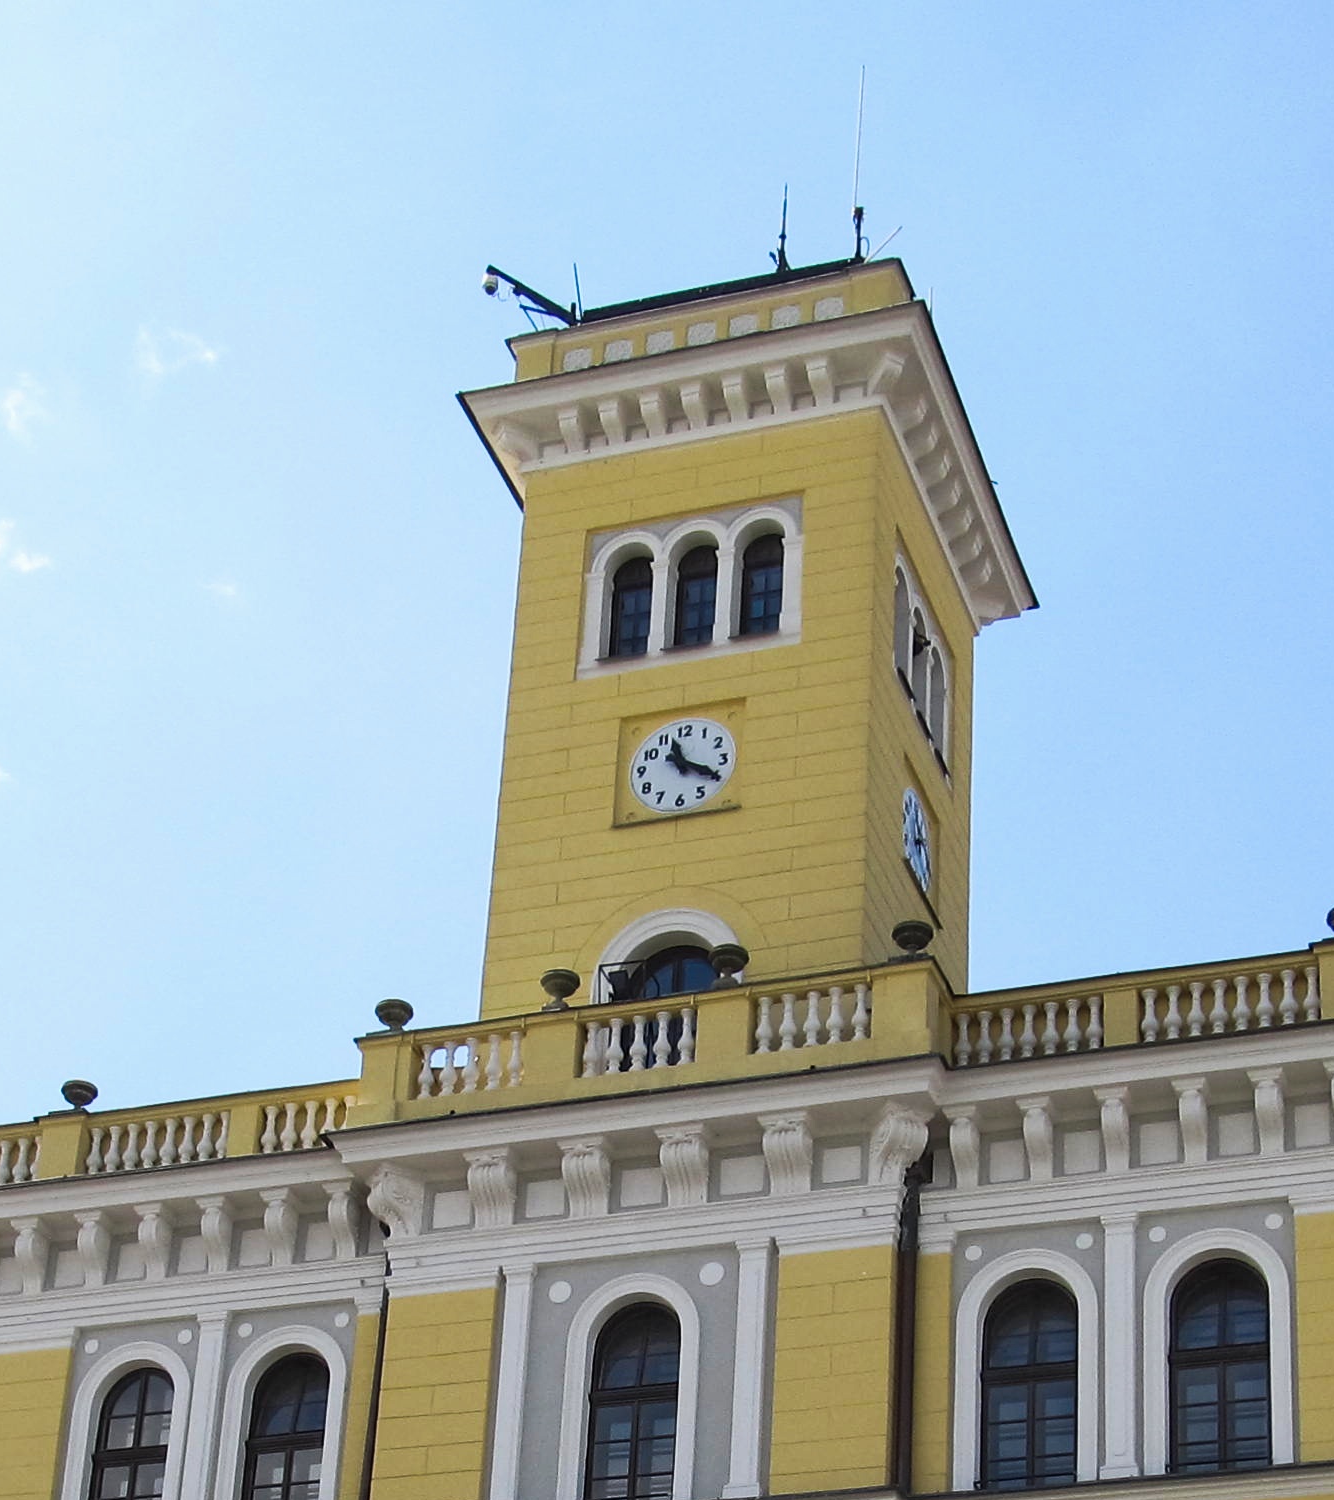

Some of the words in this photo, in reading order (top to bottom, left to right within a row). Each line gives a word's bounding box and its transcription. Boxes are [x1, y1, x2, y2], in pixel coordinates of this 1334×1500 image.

[677, 725, 693, 738] 12
[702, 728, 707, 738] 1
[658, 734, 668, 746] 11
[714, 736, 723, 749] 2
[644, 748, 659, 761] 10
[718, 753, 728, 766] 3
[637, 766, 646, 778] 9
[642, 782, 652, 794] 8
[696, 786, 705, 799] 5
[656, 791, 666, 804] 7
[675, 794, 685, 806] 6
